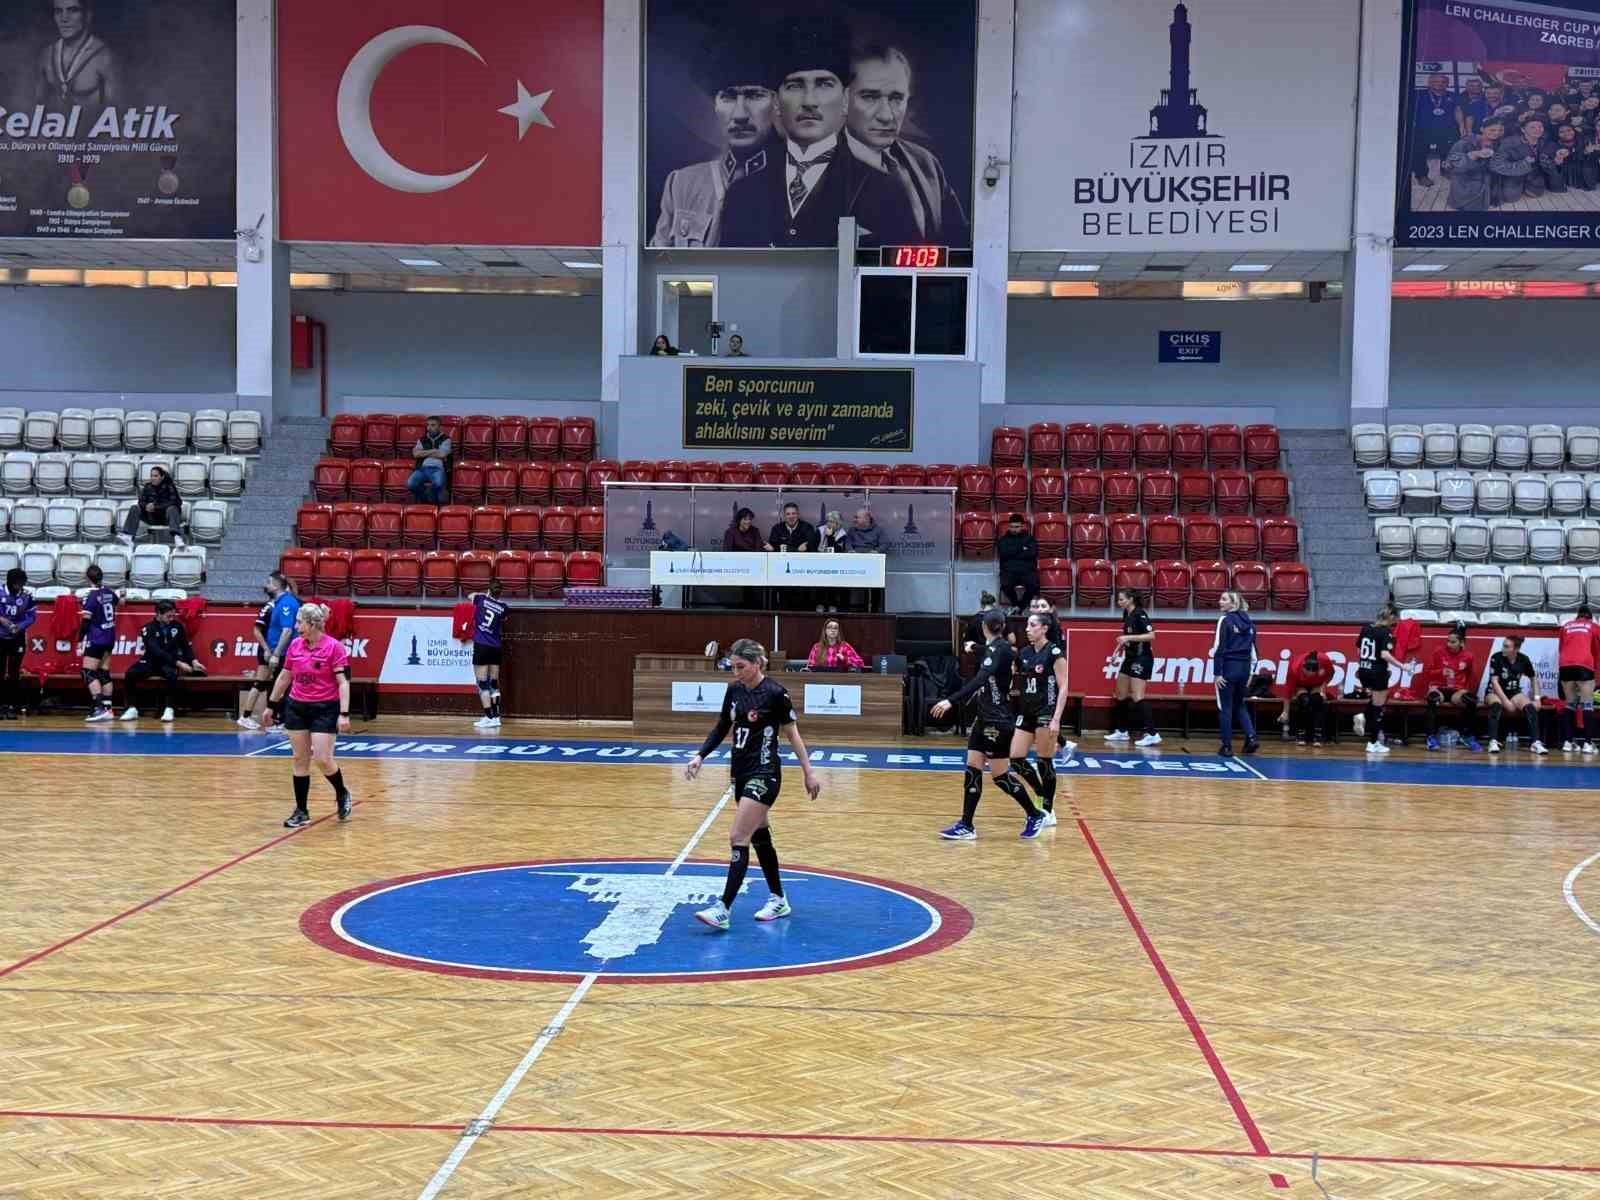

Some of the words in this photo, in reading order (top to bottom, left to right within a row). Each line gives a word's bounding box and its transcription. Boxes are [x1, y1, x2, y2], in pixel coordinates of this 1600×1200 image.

[1445, 4, 1471, 18] LEN
[1473, 8, 1560, 32] CHALLENGER
[1563, 22, 1590, 36] CUP
[1540, 31, 1594, 49] ZAGREB
[88, 105, 180, 139] Atik
[1129, 141, 1227, 169] İZMİR
[1073, 170, 1291, 206] BÜYÜKŞEHİR
[1081, 207, 1279, 236] BELEDİYESİ
[1408, 225, 1445, 239] 2023
[1448, 225, 1479, 239] LEN
[1483, 224, 1591, 239] CHALLENGER
[895, 247, 939, 267] 17:03
[1169, 333, 1211, 345] ÇIKIŞ
[1178, 347, 1200, 355] EXIT
[704, 375, 733, 393] Ben
[737, 379, 816, 397] sporcunun
[695, 399, 727, 418] zeki,
[732, 400, 770, 420] çevik
[776, 405, 793, 417] ve
[797, 405, 827, 421] aynı
[831, 401, 894, 418] zamanda
[695, 421, 765, 440] ahlaklısını
[1360, 637, 1377, 661] 61
[735, 727, 750, 749] 17
